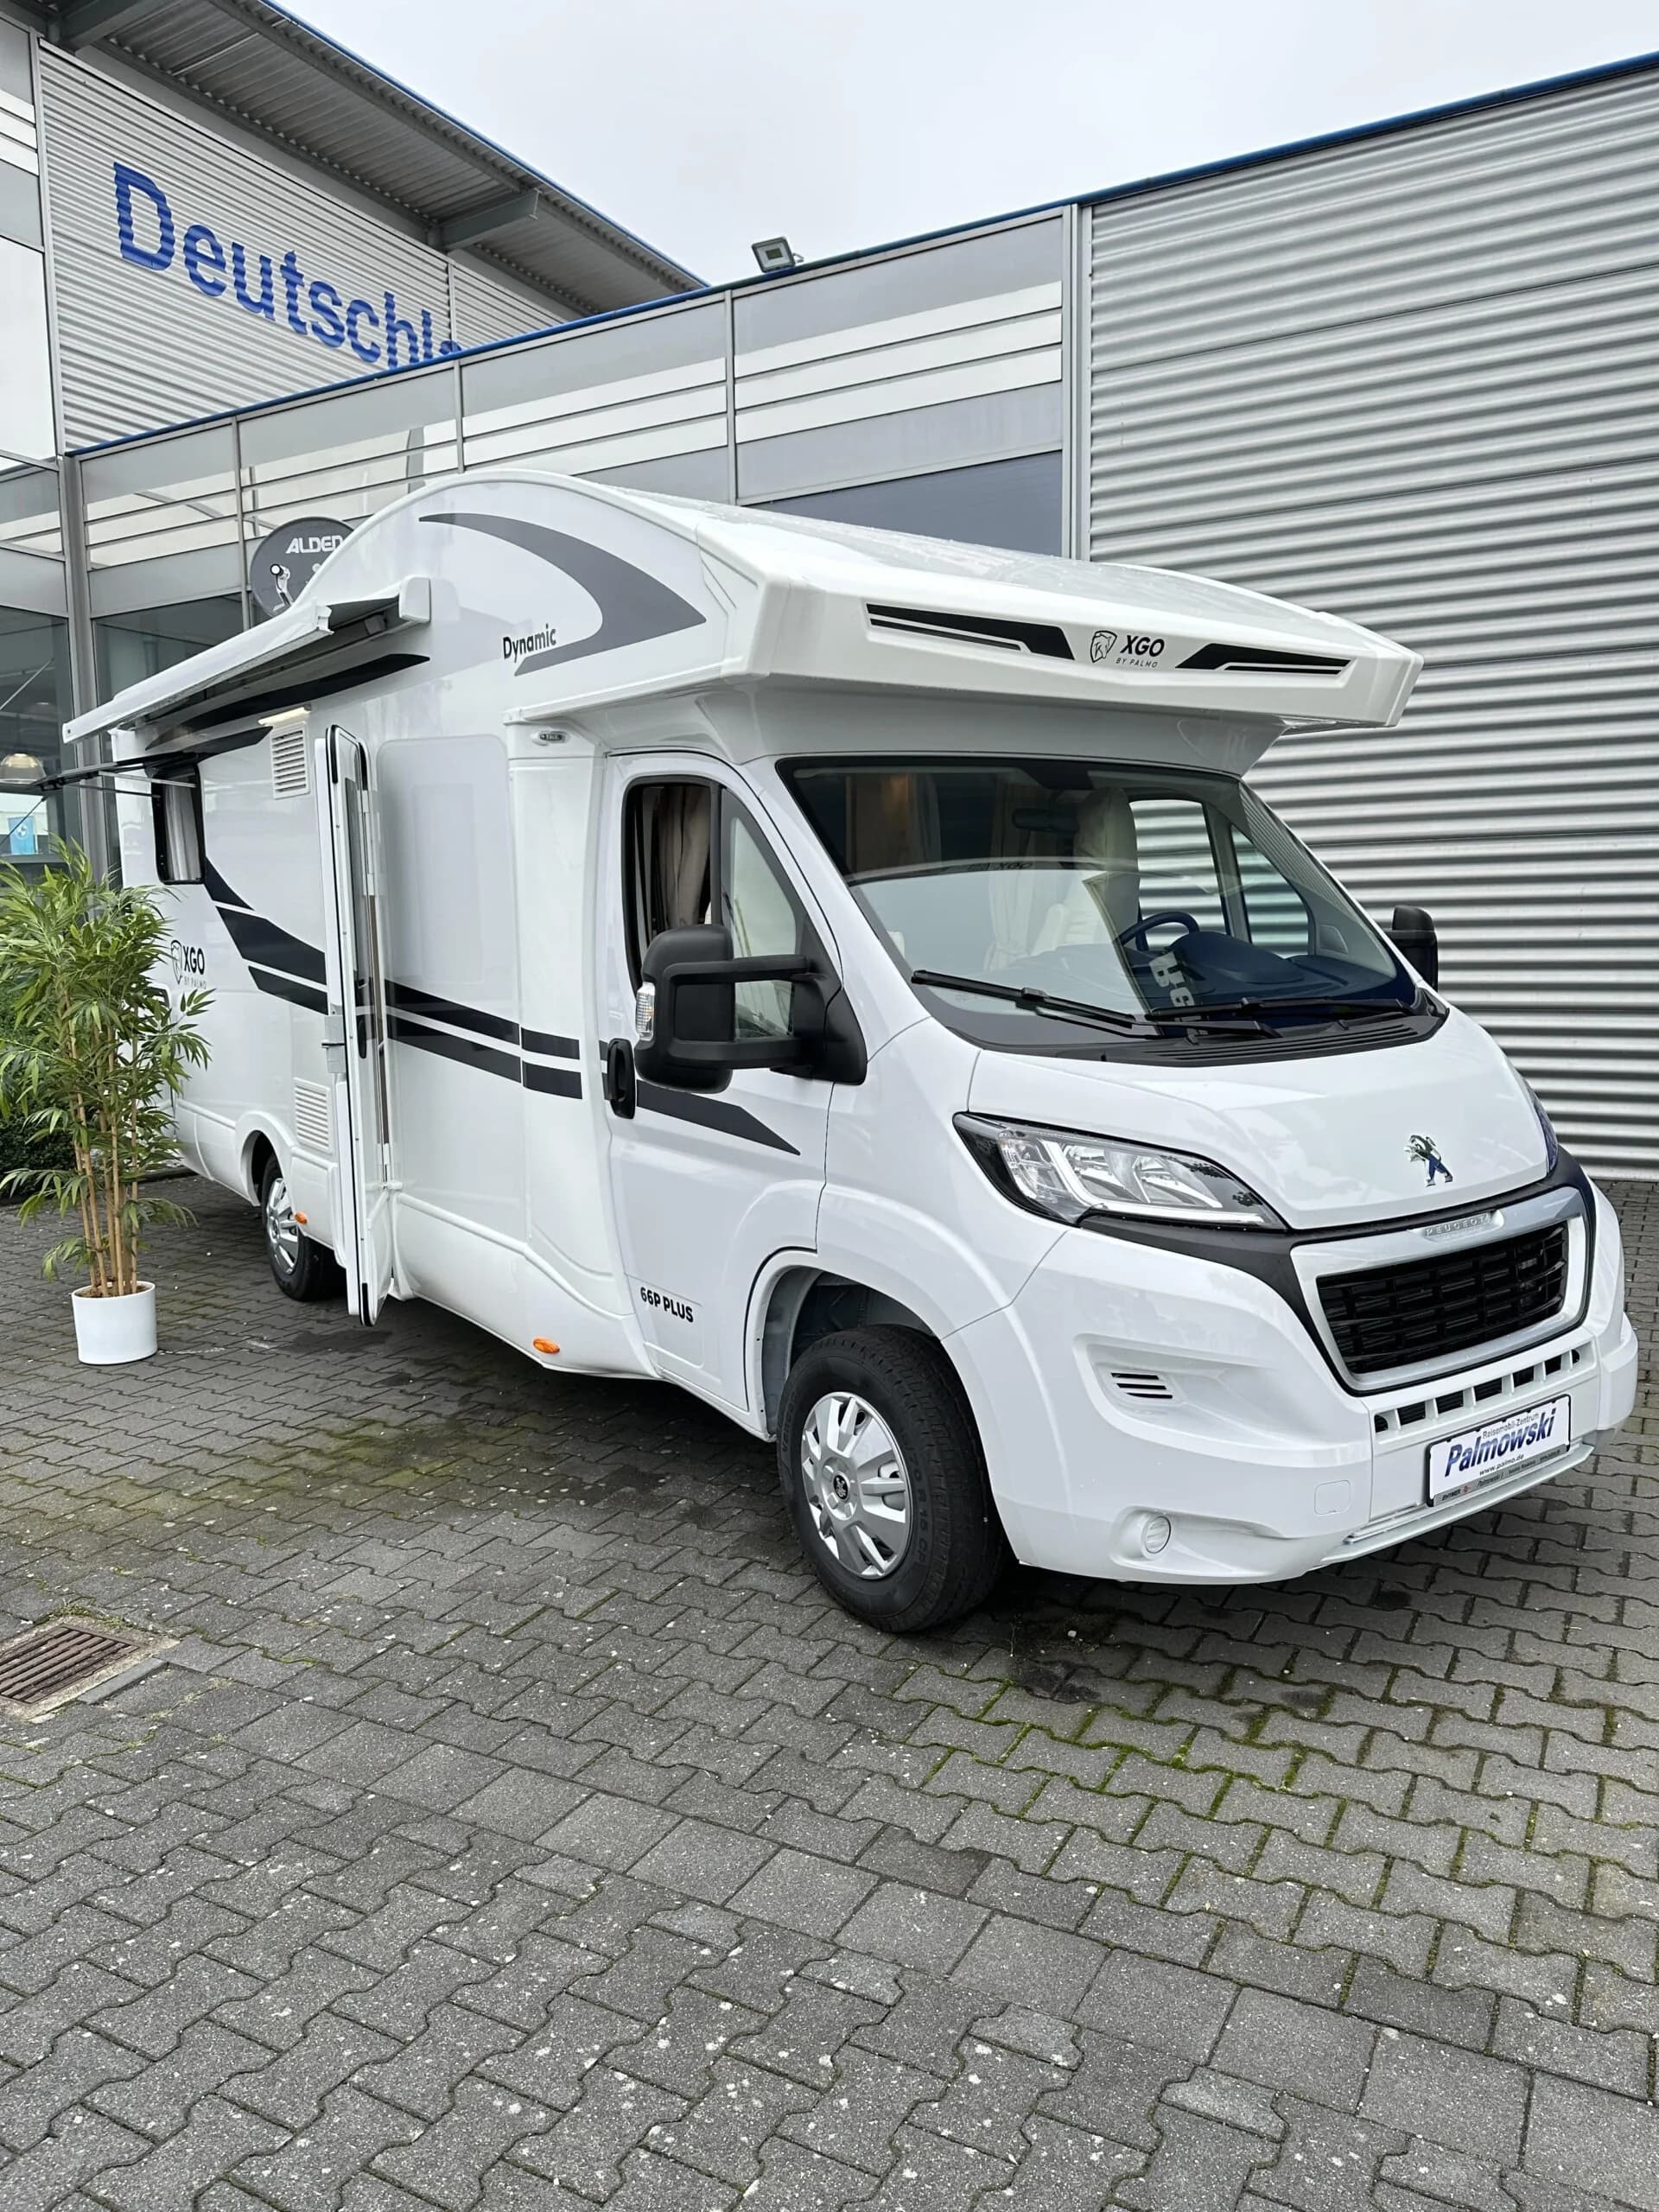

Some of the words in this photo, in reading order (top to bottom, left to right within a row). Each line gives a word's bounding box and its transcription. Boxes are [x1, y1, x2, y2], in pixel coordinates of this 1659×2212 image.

[503, 623, 556, 663] Dynamic
[1120, 634, 1165, 657] XGO
[1129, 658, 1158, 668] PALMO
[183, 945, 205, 975] XGO
[1425, 1214, 1489, 1236] PEUGEOT
[640, 1286, 661, 1307] 66P
[663, 1295, 694, 1323] PLUS
[1444, 1408, 1557, 1477] Palmowski
[1478, 1453, 1525, 1477] www.palmo.de
